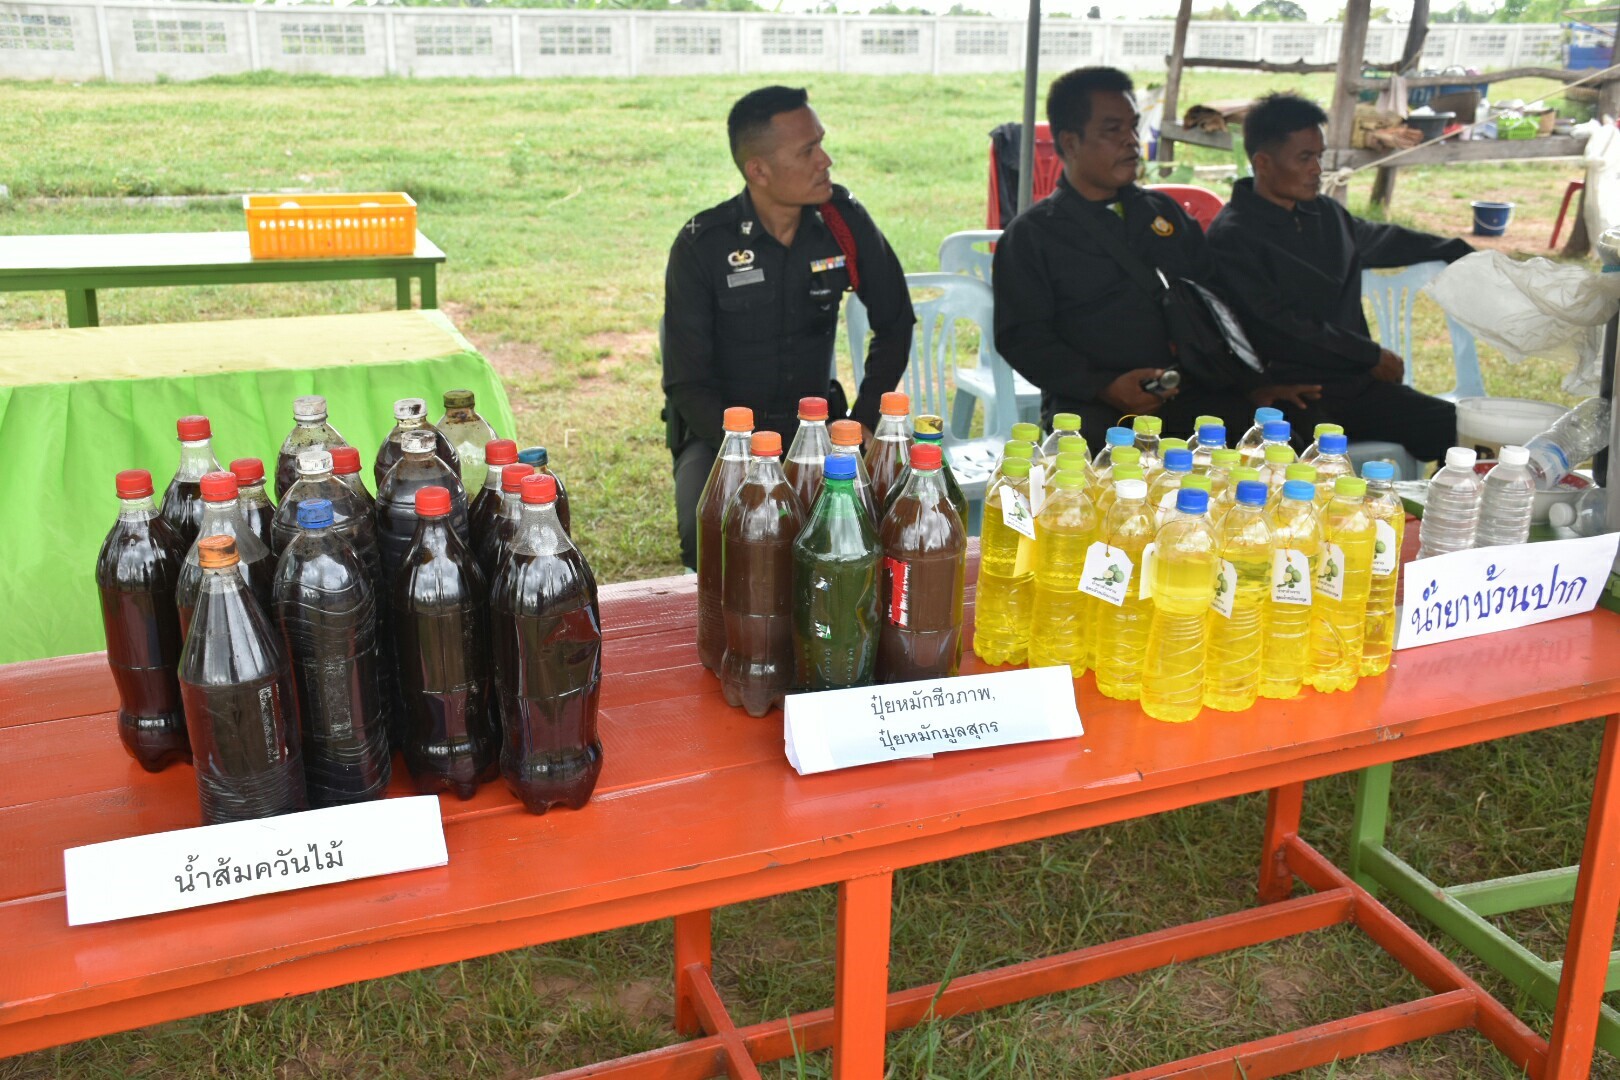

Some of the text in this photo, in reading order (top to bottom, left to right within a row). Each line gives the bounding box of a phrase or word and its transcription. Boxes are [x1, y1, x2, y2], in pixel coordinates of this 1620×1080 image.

[1412, 564, 1587, 634] น้ำยาบ้วนปาก
[879, 720, 999, 751] ปุ๋ยหมักมูลสุกร
[175, 840, 343, 892] น้ำส้มควันไม้
